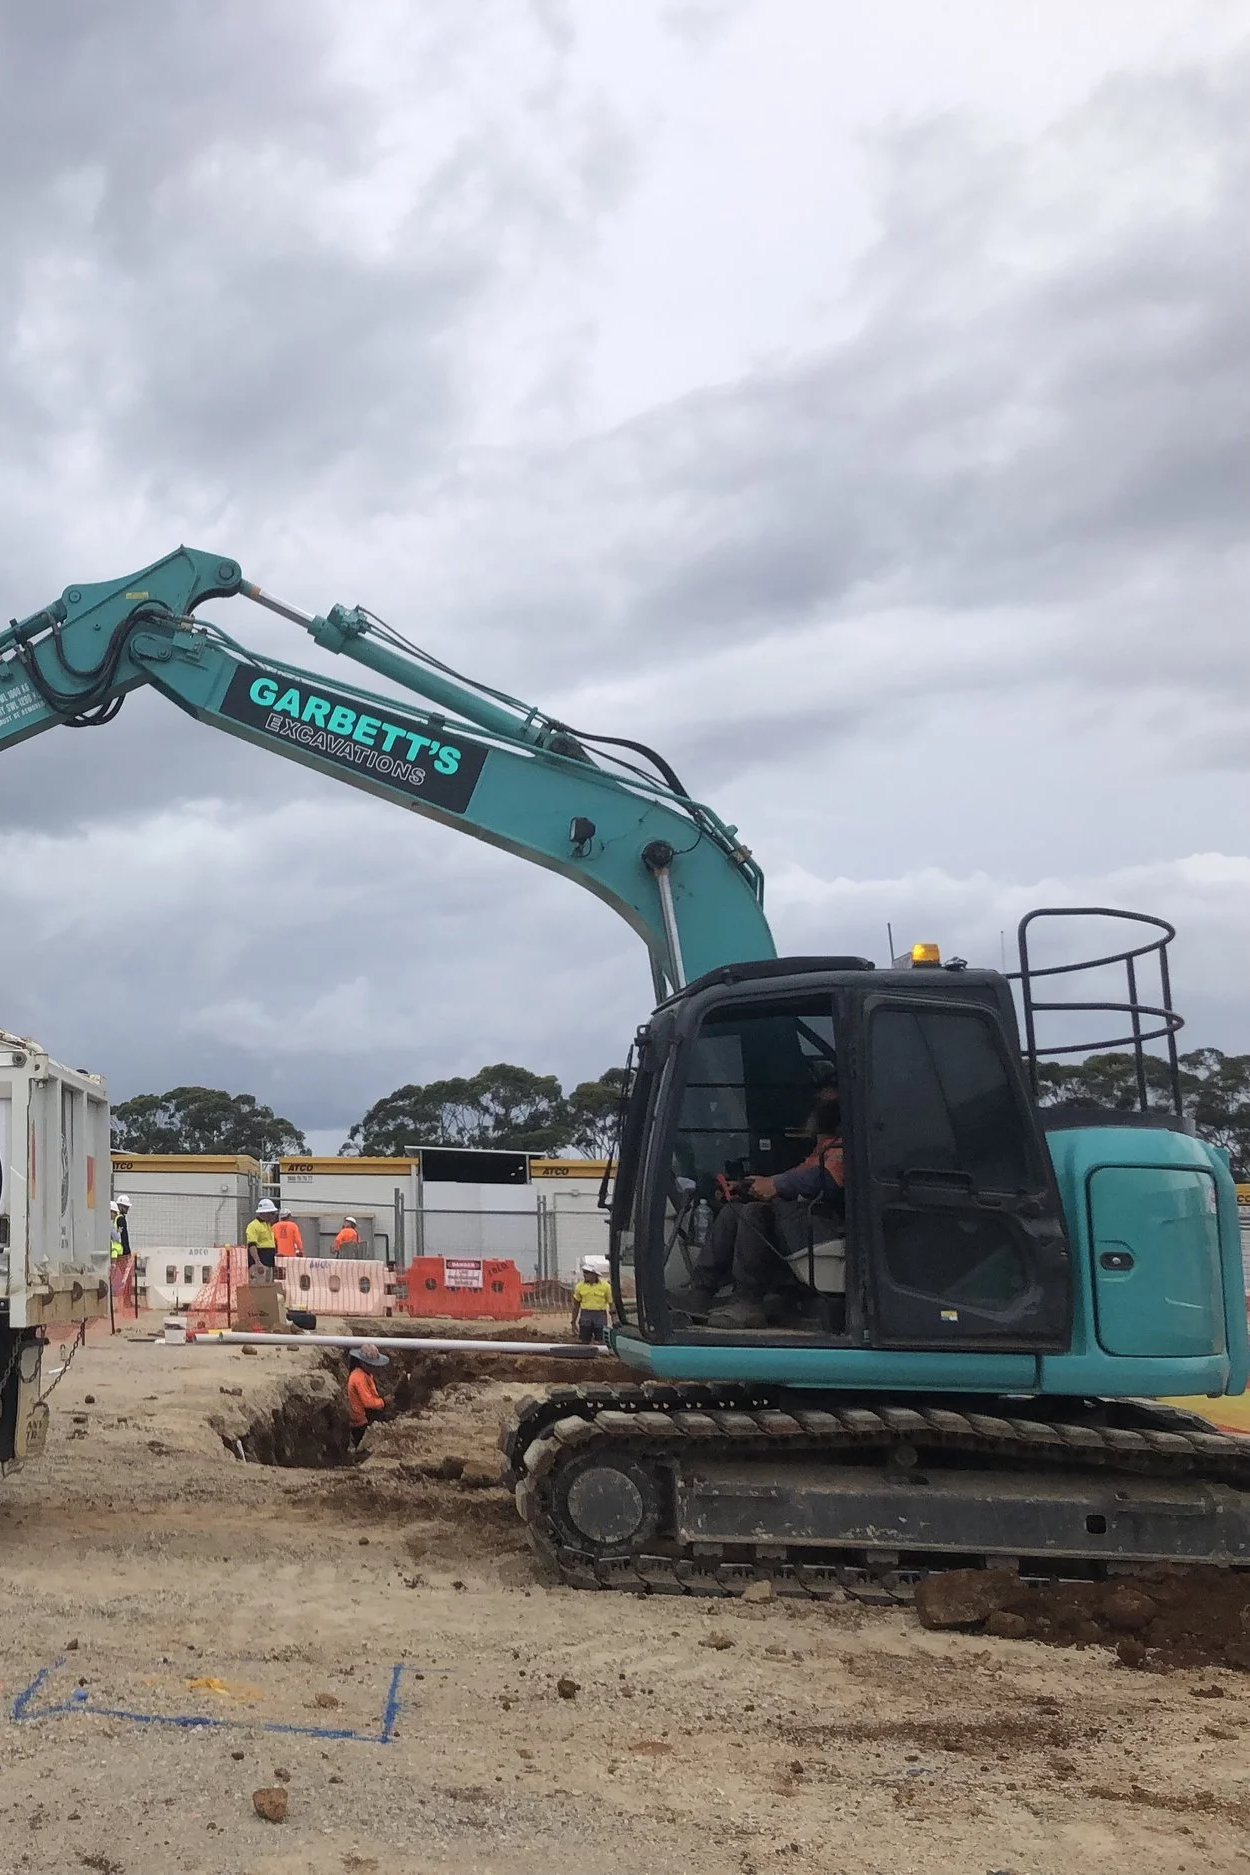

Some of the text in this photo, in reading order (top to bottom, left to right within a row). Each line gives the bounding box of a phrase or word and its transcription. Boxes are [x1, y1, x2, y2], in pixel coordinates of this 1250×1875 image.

[249, 677, 462, 775] GARBETT'S
[265, 713, 426, 786] EXCAVATIONS
[288, 1163, 314, 1172] ATCO
[542, 1167, 570, 1176] ATCO
